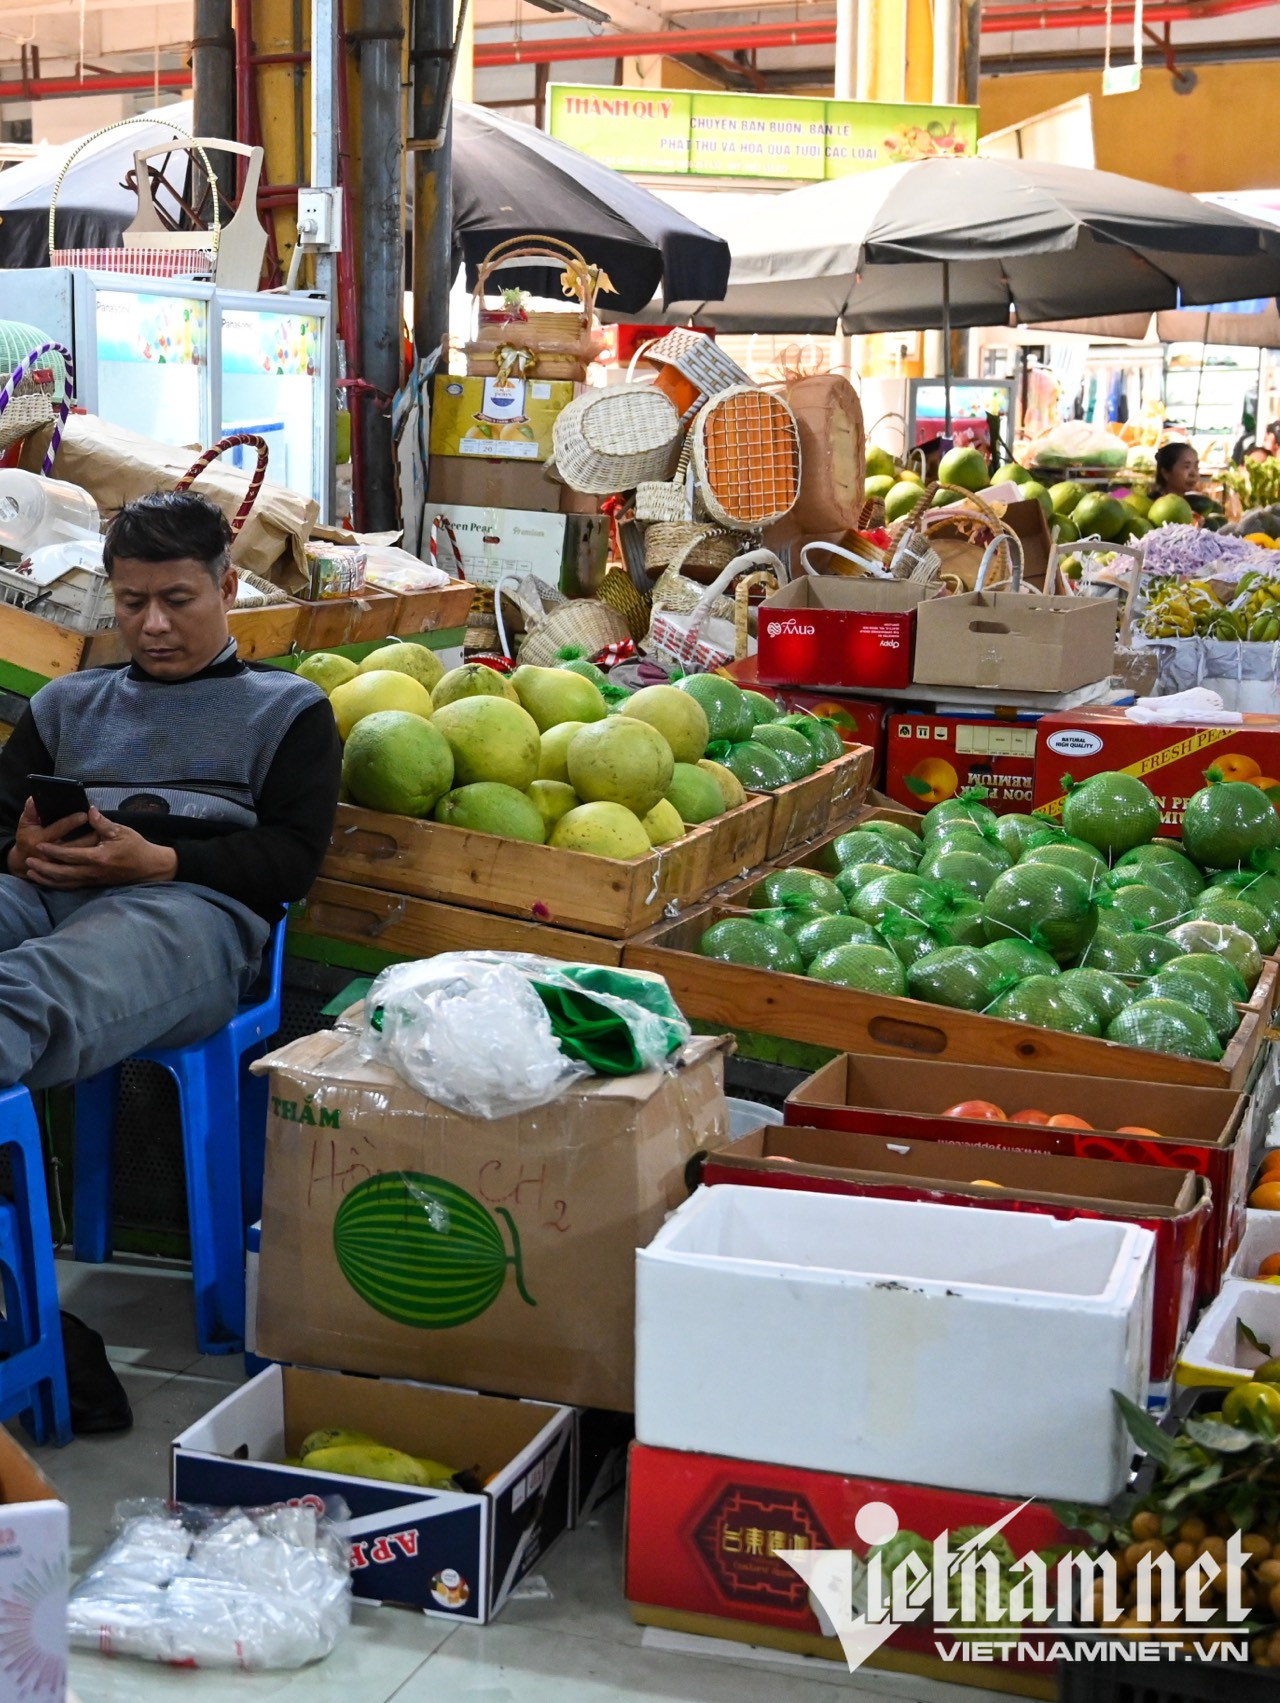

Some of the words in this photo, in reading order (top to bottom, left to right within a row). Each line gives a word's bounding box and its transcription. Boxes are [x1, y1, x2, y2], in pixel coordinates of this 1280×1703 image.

[782, 618, 815, 635] envy
[1141, 740, 1193, 773] FRESH
[1198, 728, 1237, 748] PEA
[968, 773, 1033, 788] REMIUM
